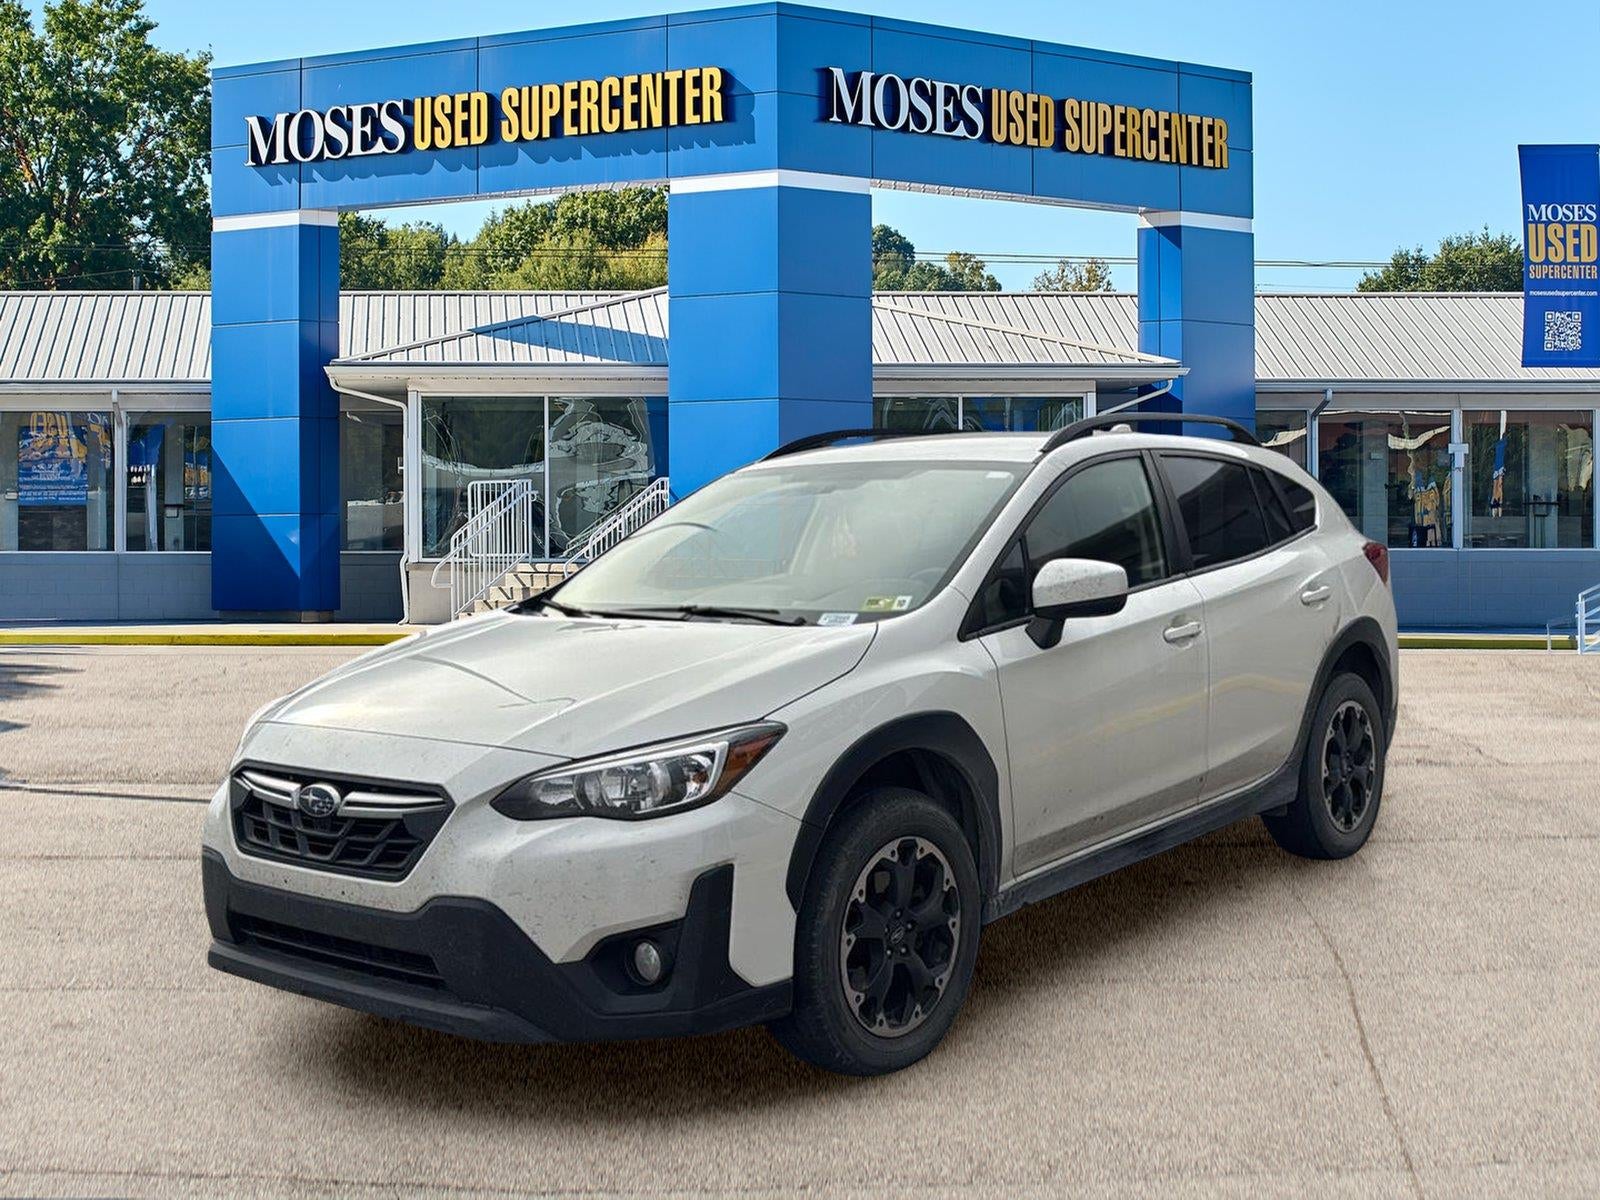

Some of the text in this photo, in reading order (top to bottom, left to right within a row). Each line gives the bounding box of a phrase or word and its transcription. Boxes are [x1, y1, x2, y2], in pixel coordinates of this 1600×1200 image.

[245, 66, 723, 167] MOSES USED SUPERCENTER
[828, 67, 1229, 169] MOSES USED SUPERCENTER
[1527, 203, 1597, 222] MOSES
[1528, 223, 1598, 263] USED
[1529, 265, 1598, 280] SUPERCENTER
